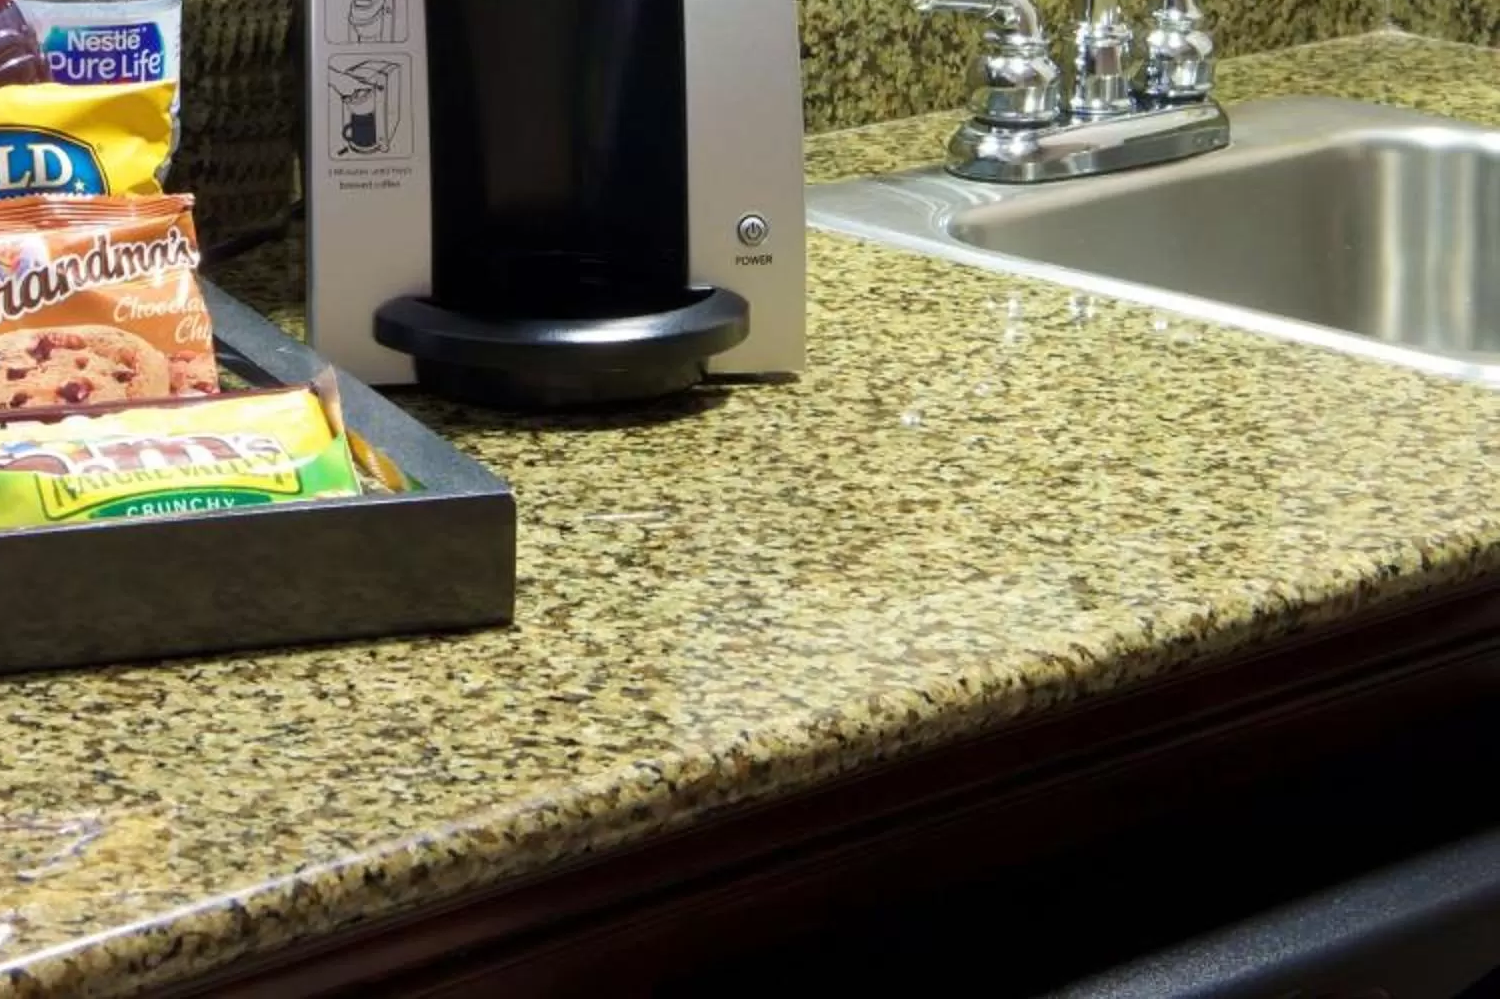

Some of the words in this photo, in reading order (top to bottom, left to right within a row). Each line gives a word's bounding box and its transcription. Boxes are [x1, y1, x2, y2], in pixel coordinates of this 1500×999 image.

[48, 51, 117, 79] Pure
[121, 49, 162, 82] Life
[734, 254, 773, 266] POWER
[51, 466, 173, 507] NATURE
[126, 497, 236, 518] CRUNCHY
